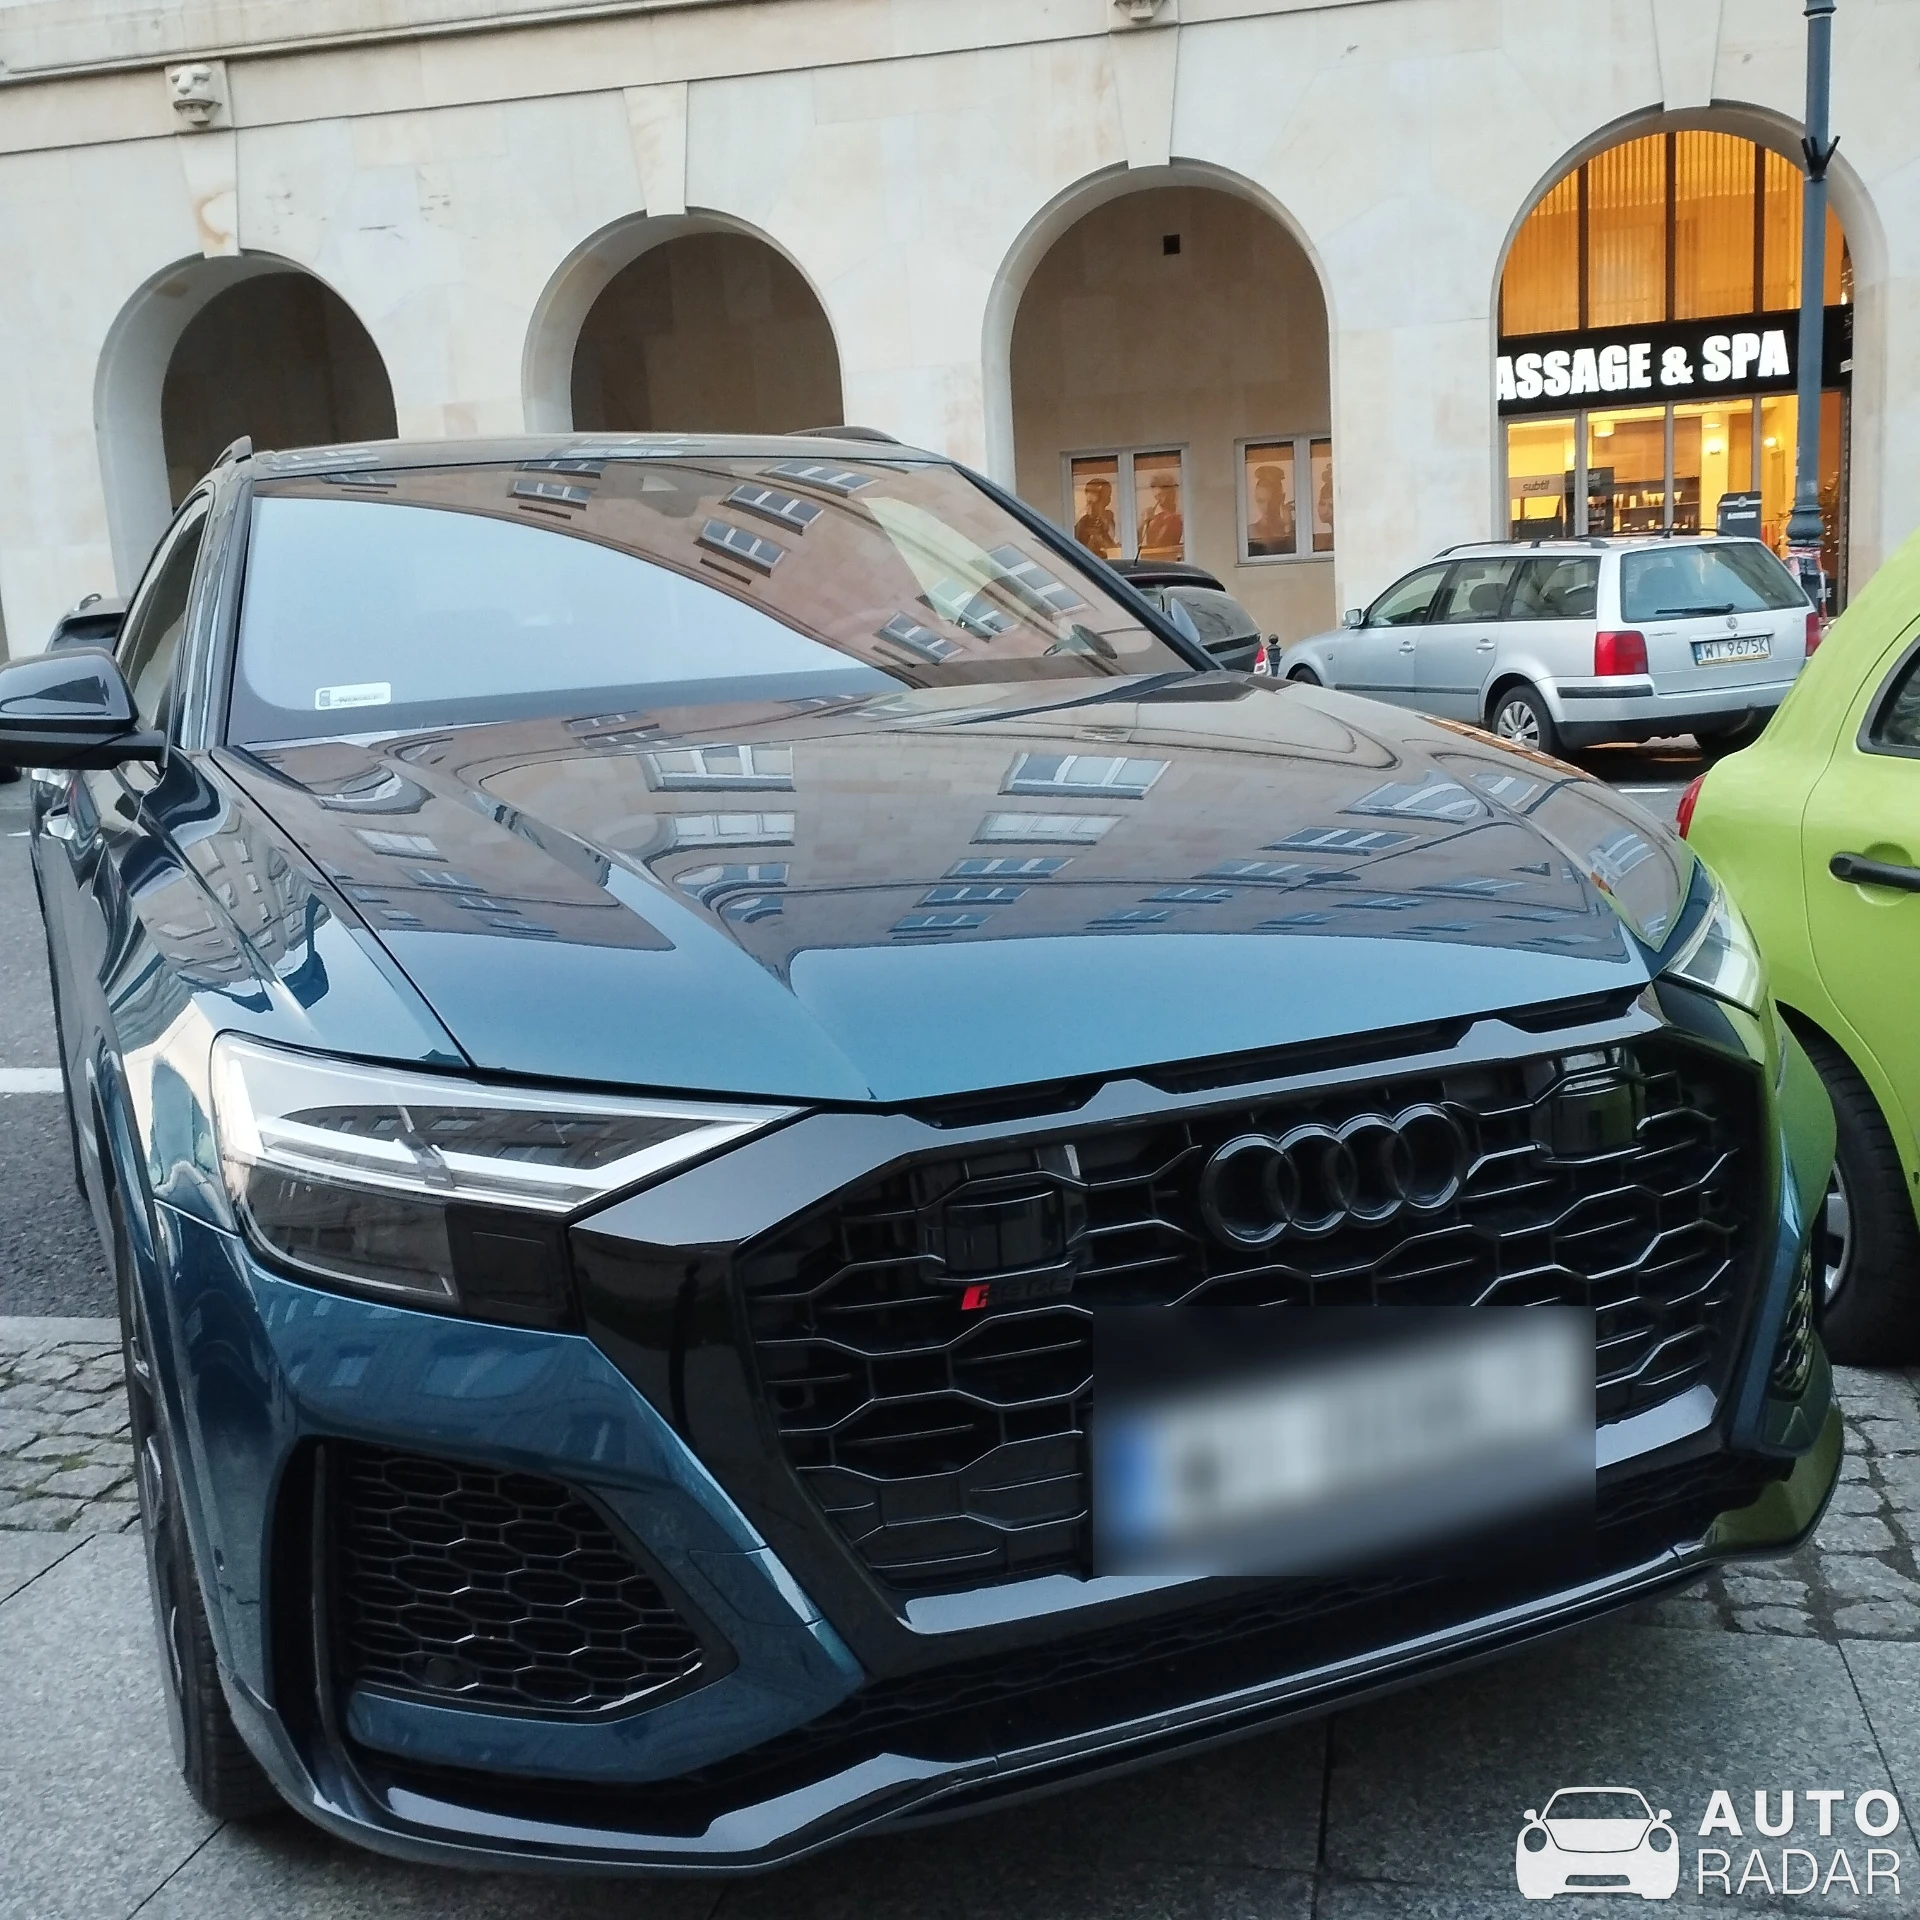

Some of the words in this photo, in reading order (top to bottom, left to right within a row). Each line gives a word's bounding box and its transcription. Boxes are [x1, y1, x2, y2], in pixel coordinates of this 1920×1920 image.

[1496, 344, 1652, 401] ASSAGE
[1661, 346, 1693, 386] &
[1703, 330, 1790, 383] SPA
[1522, 480, 1550, 492] subtil
[1727, 638, 1767, 656] 9675K
